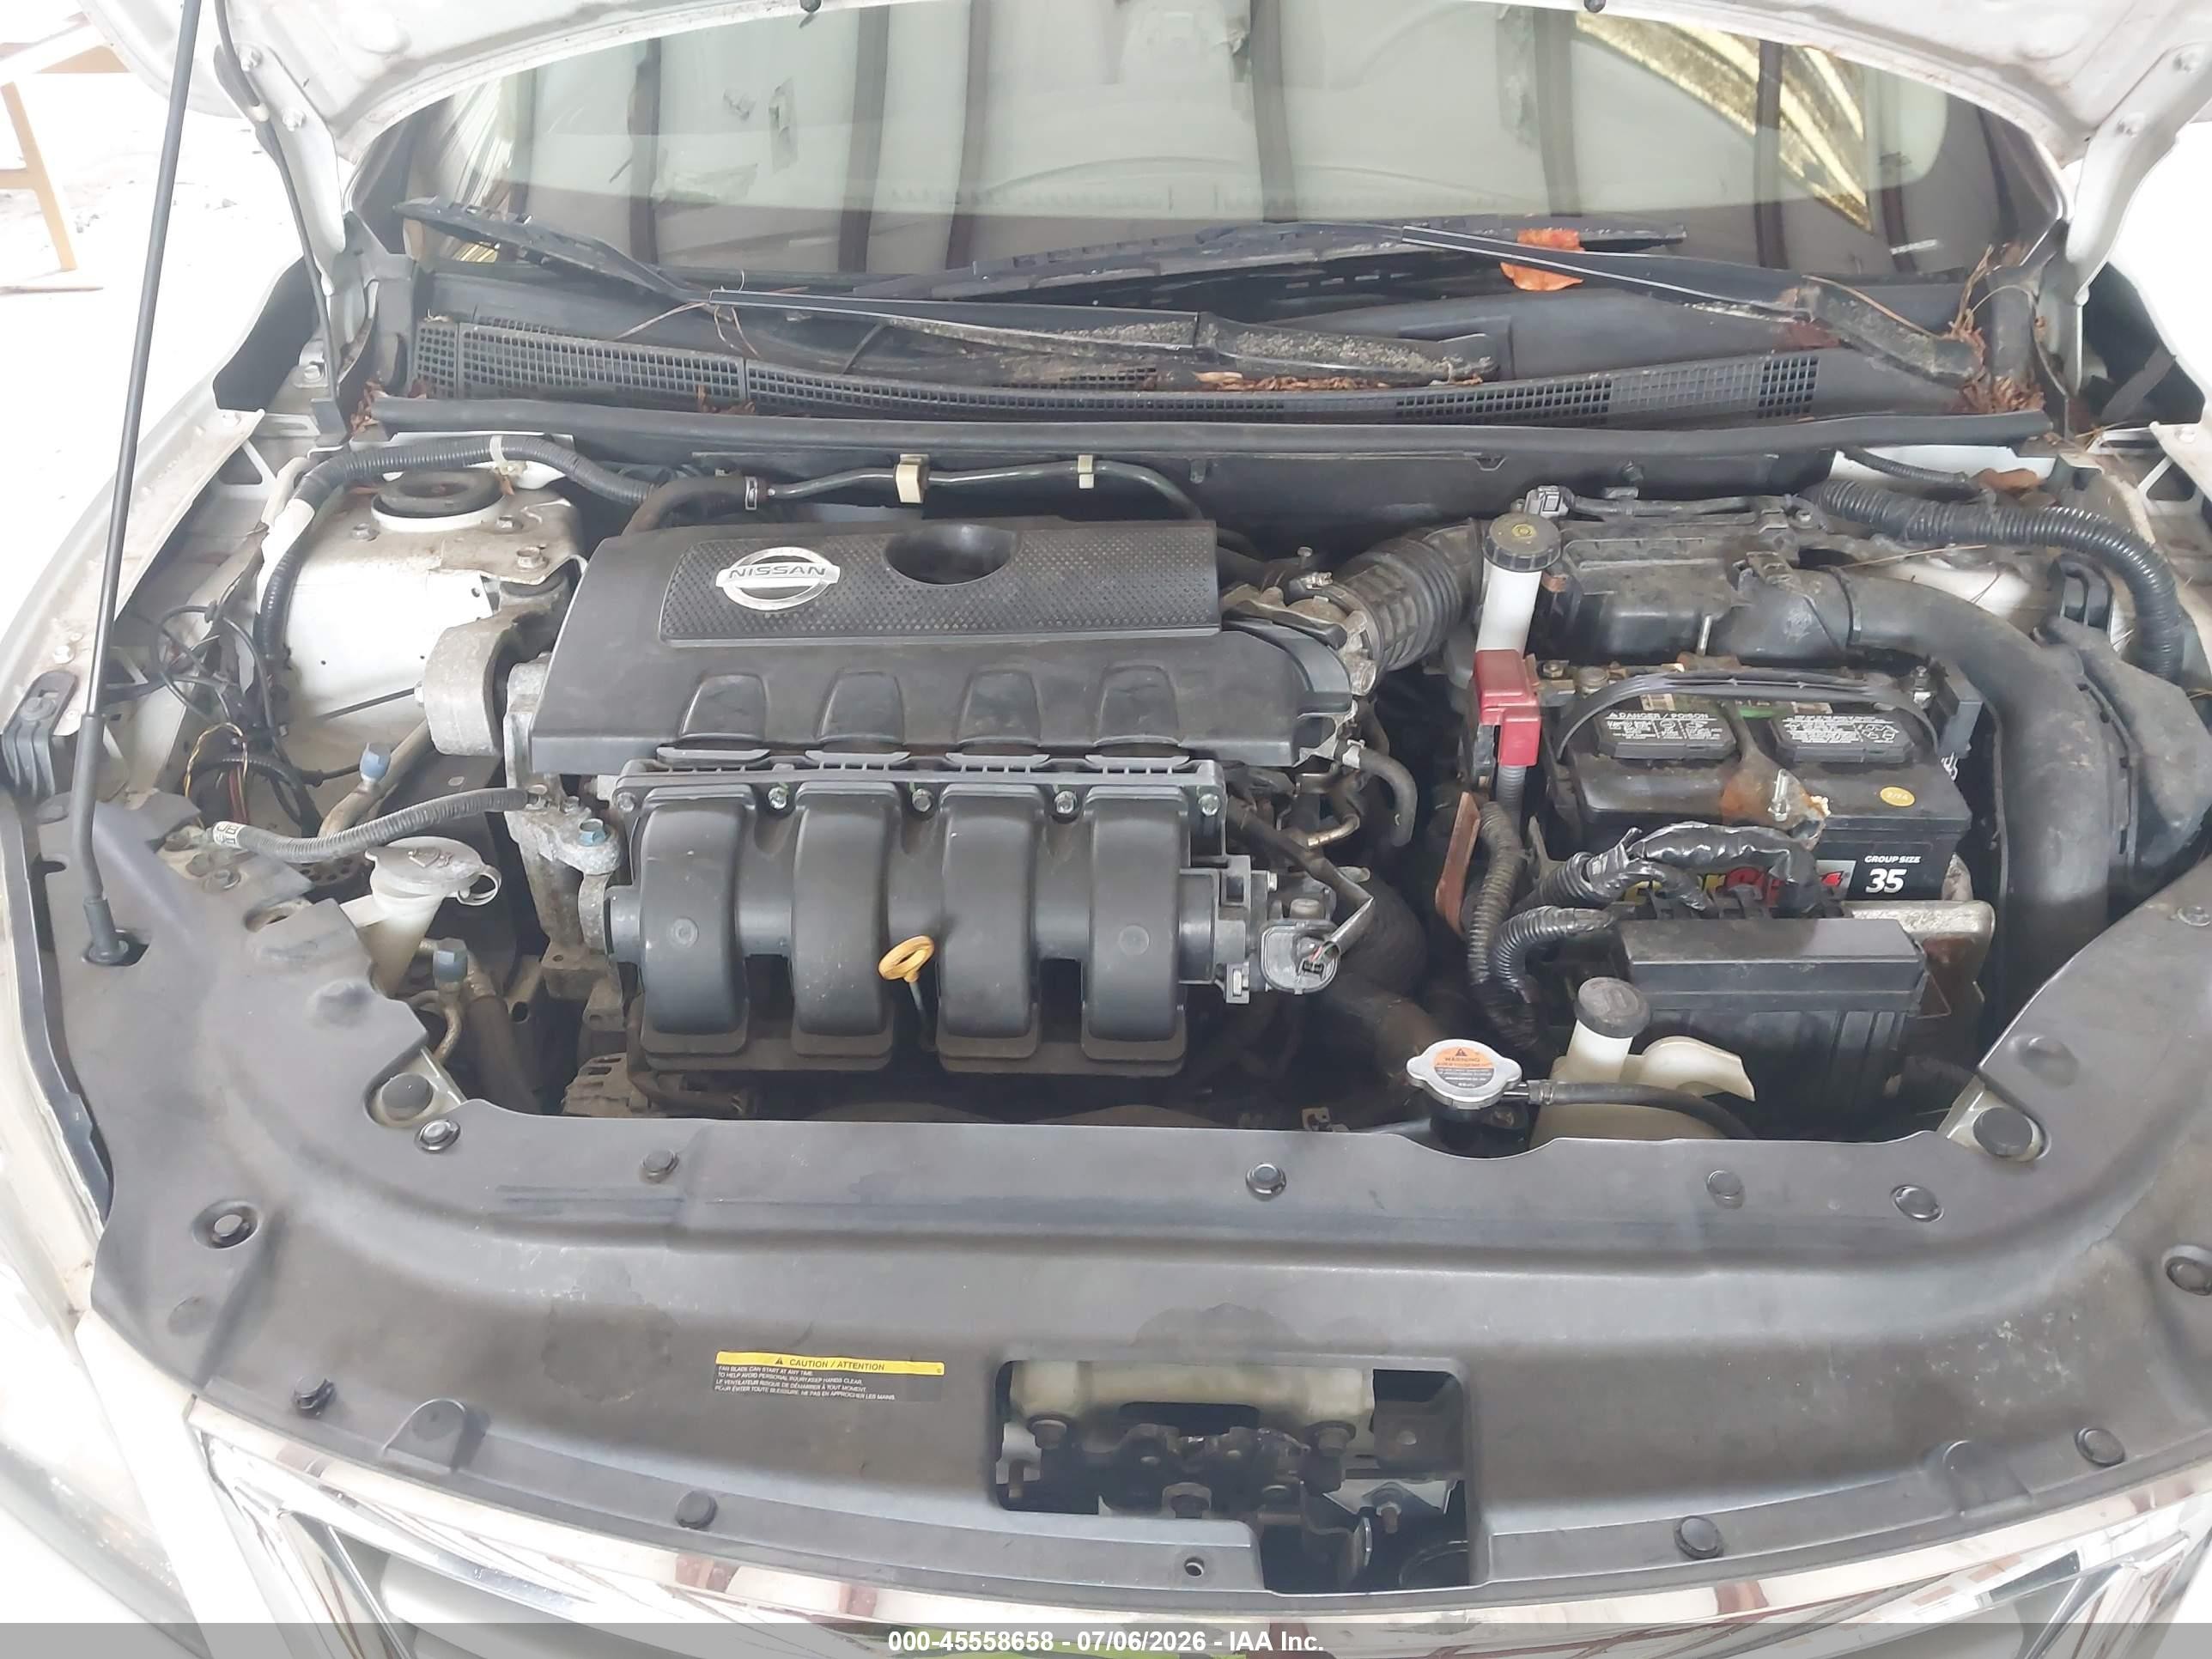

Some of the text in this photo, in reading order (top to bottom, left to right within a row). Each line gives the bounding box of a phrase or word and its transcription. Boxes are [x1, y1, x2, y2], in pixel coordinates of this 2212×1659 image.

[729, 566, 825, 579] NISSAN
[1865, 868, 1907, 893] 35
[790, 1358, 828, 1368] CAUTION
[838, 1361, 884, 1370] ATTENTION
